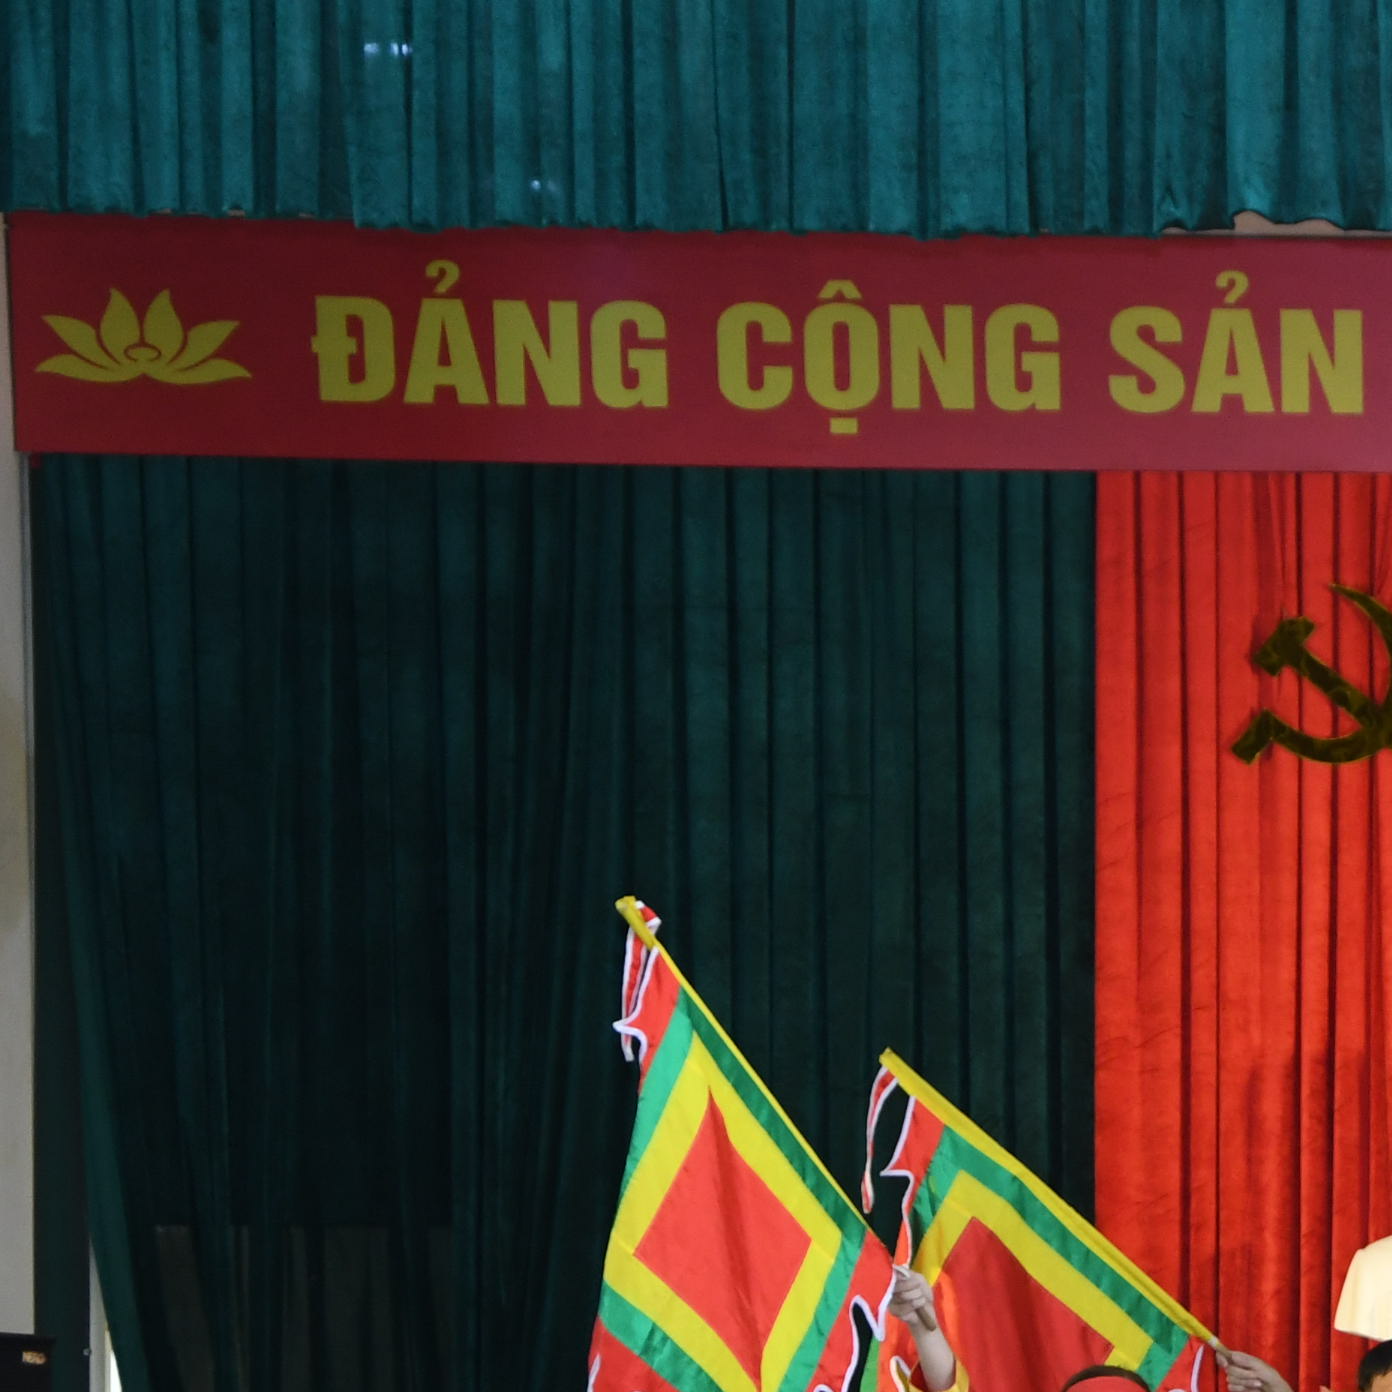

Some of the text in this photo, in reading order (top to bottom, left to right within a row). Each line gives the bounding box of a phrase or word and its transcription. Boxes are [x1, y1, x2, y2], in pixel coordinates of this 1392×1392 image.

[312, 260, 669, 408] ĐẢNG
[718, 280, 1061, 434] CỘNG
[1110, 271, 1364, 413] SẢN
